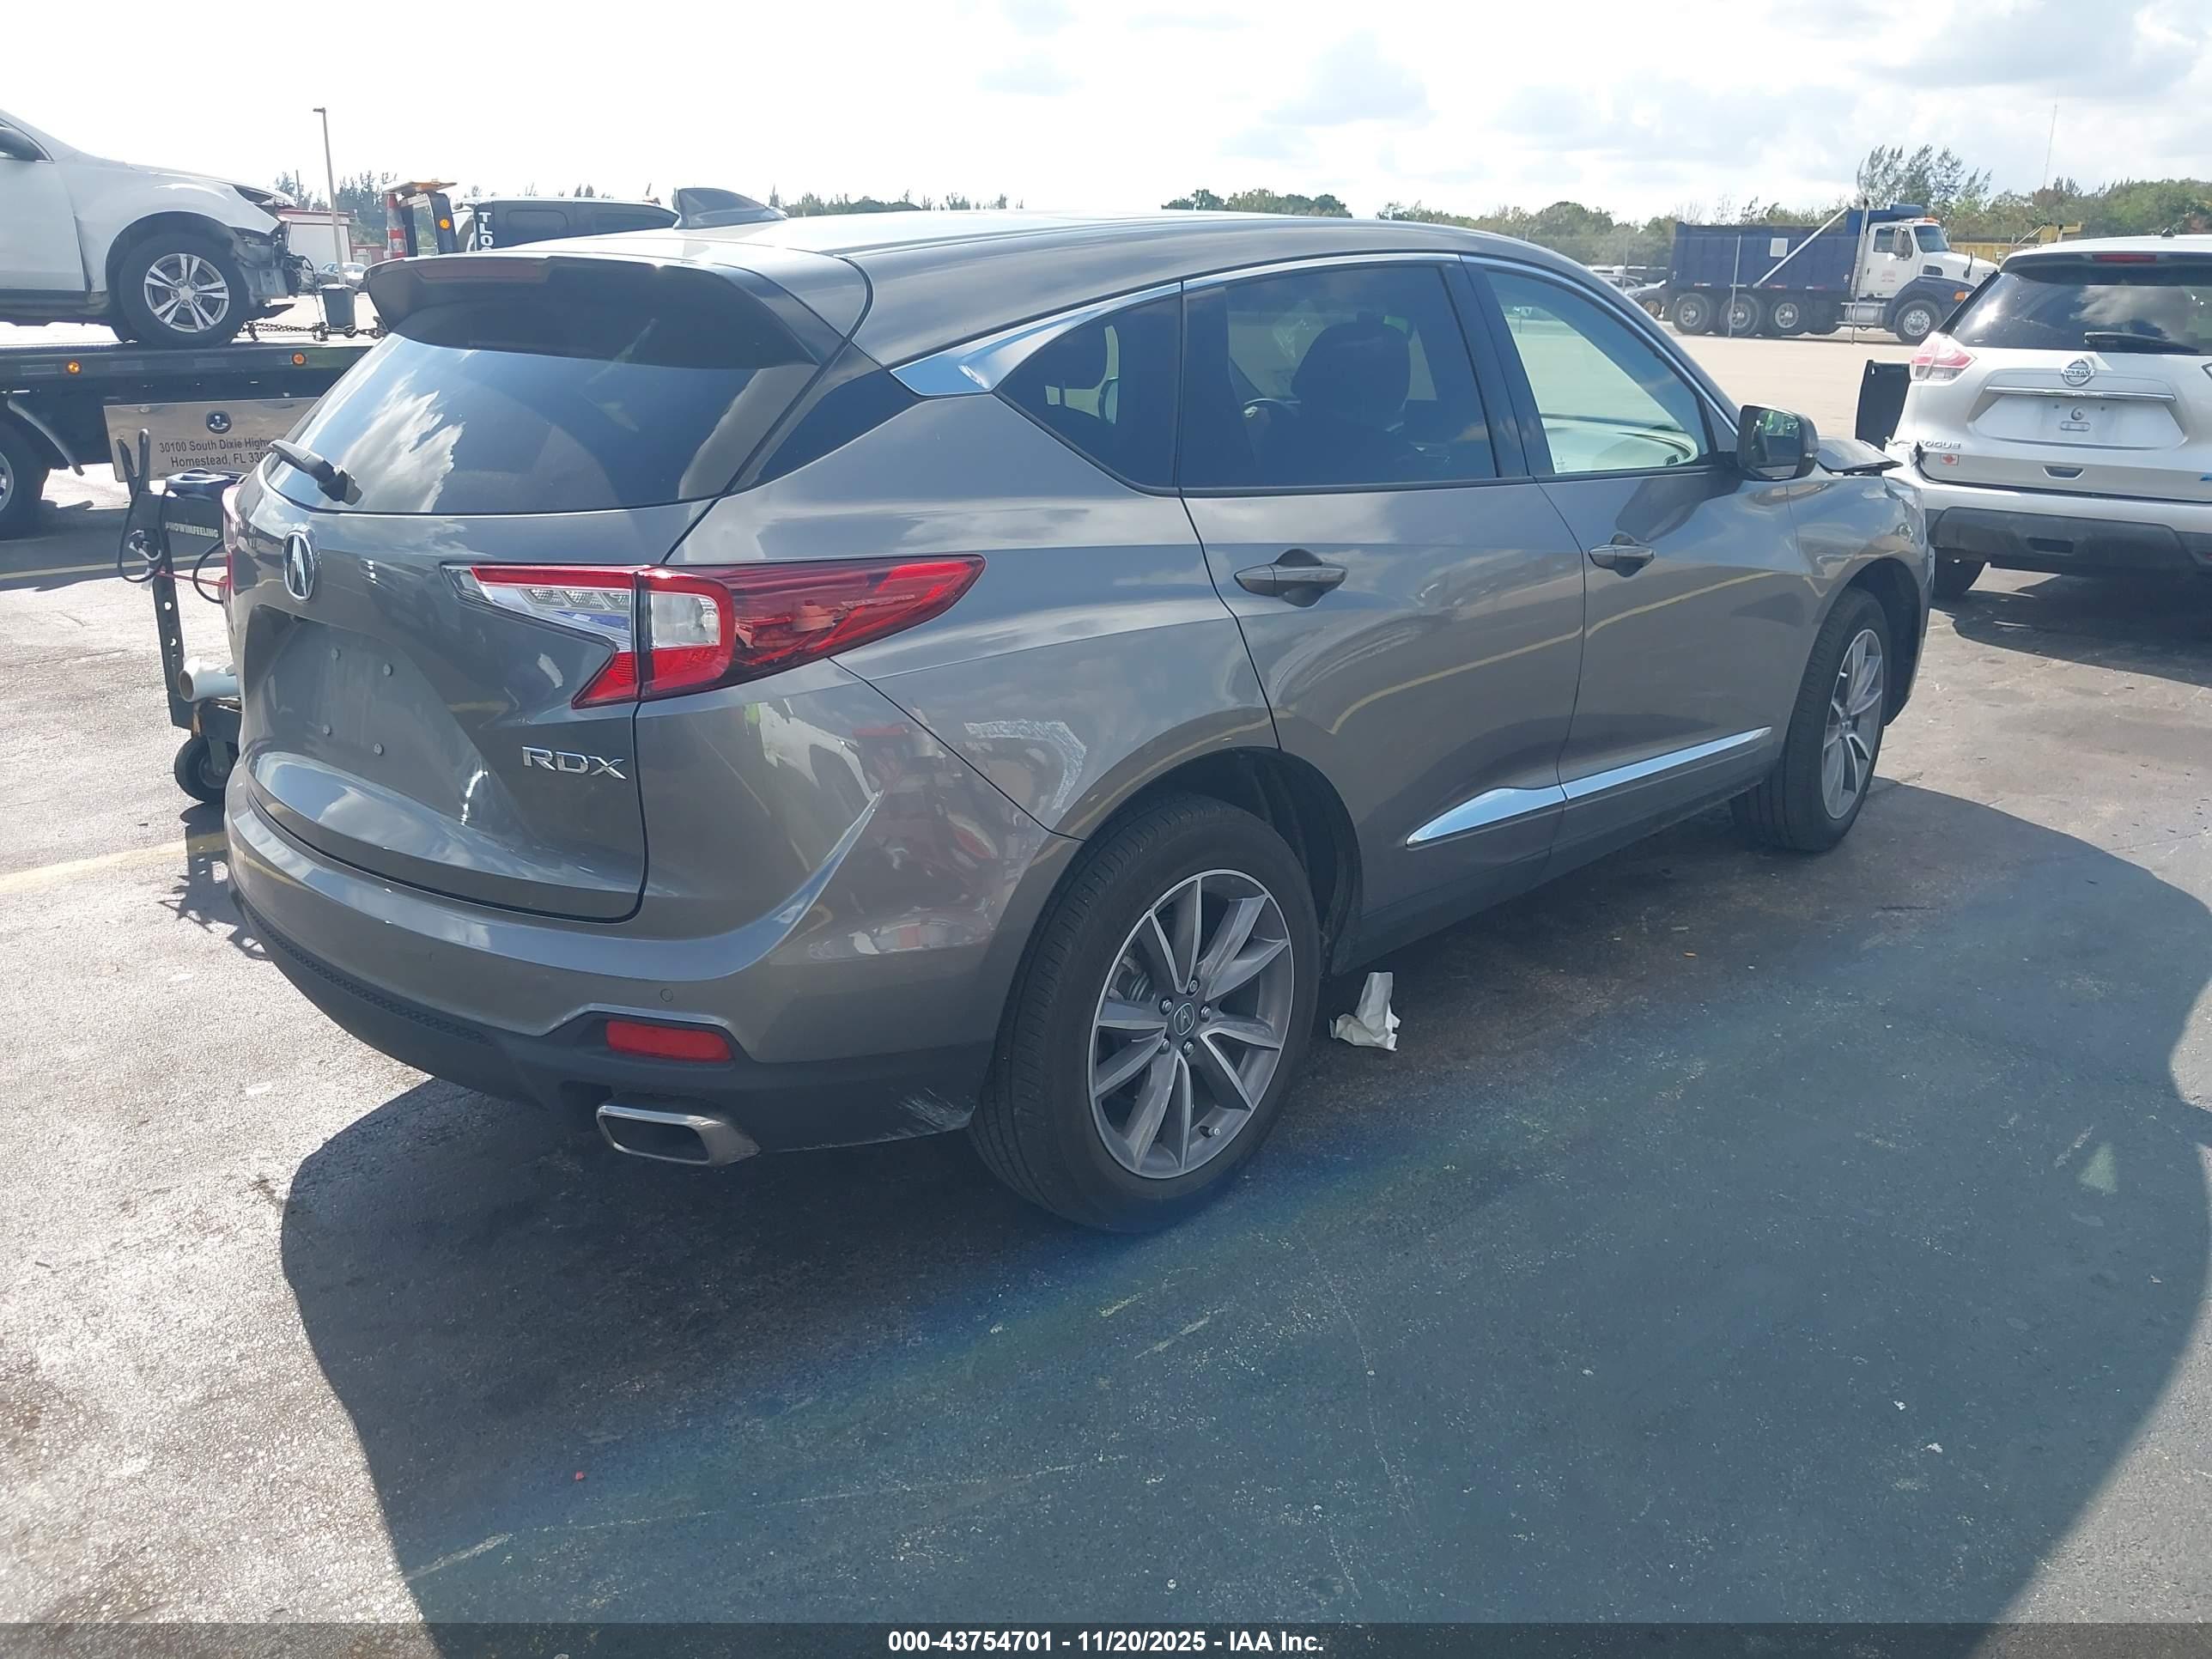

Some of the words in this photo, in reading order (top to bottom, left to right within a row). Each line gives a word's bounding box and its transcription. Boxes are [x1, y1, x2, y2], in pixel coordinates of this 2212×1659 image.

[478, 211, 494, 250] TLO
[159, 441, 186, 453] 30100
[189, 440, 216, 452] South
[219, 438, 241, 449] Dixie
[244, 437, 271, 450] Highw
[171, 454, 231, 467] Homestead,
[234, 453, 246, 464] FL
[248, 452, 271, 463] 330
[522, 745, 628, 780] RDX
